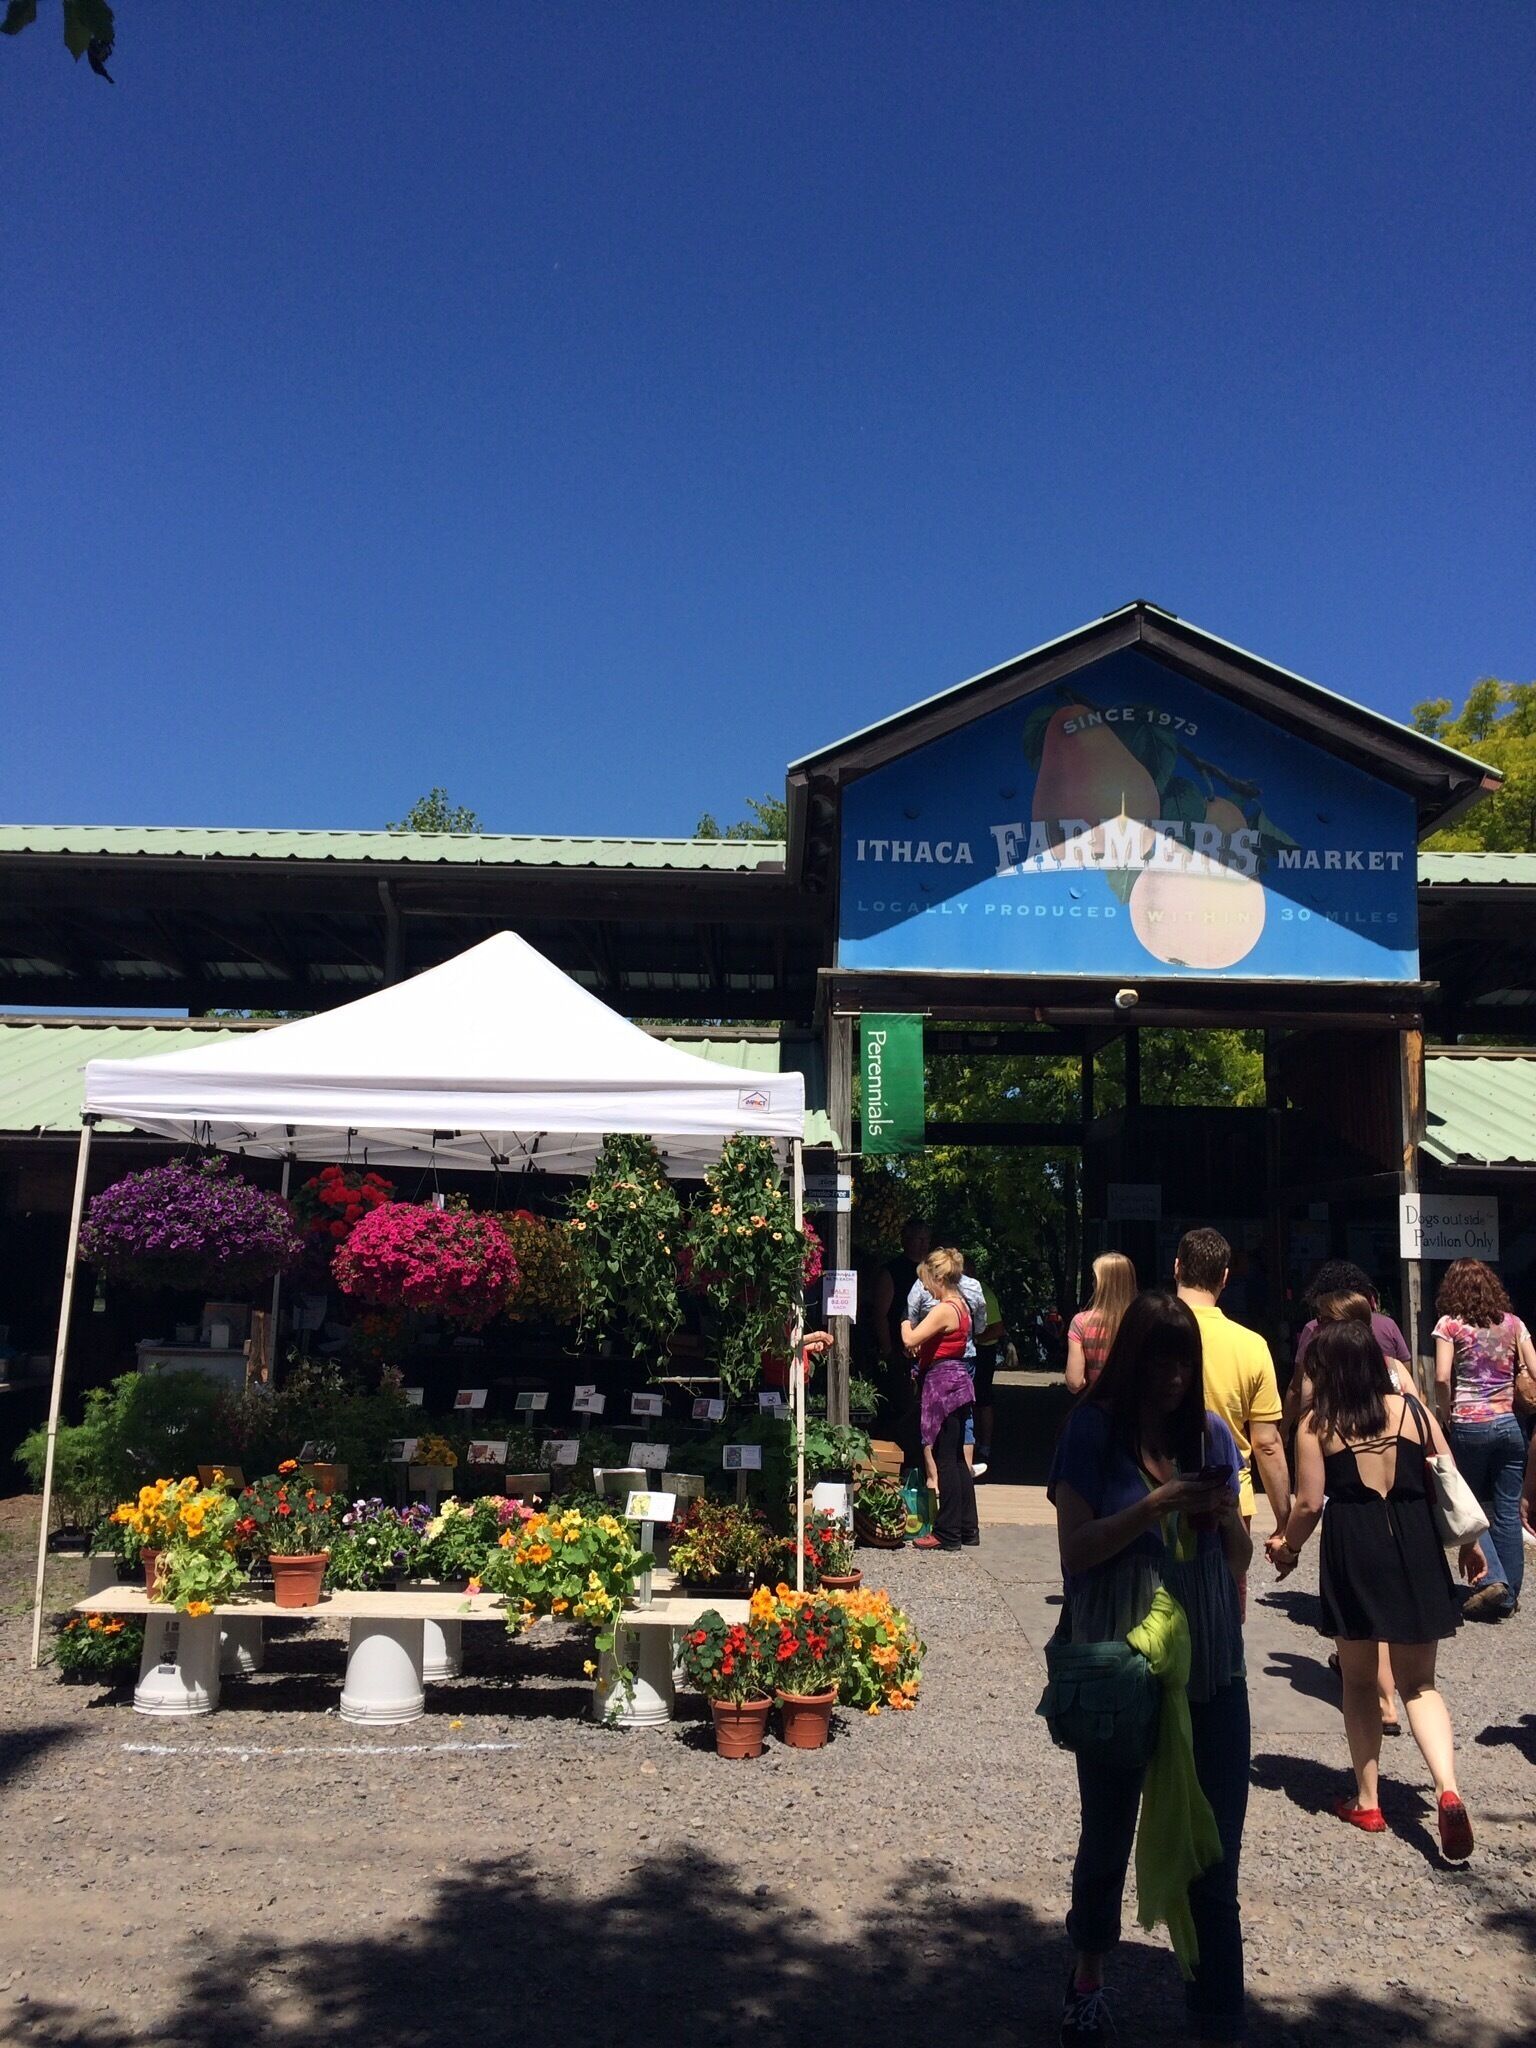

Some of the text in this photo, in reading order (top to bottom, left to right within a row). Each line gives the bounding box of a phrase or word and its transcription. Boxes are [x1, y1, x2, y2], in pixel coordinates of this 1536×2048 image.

[1063, 708, 1199, 736] SINCE 1973
[856, 818, 1404, 880] ITHACA FARMERS MARKET
[857, 900, 1399, 924] LOCALLY PRODUCED WITHIN 30 MILES
[867, 1030, 894, 1136] Perennials
[1405, 1205, 1440, 1228] Dogs
[1414, 1229, 1495, 1252] Pavilion Only
